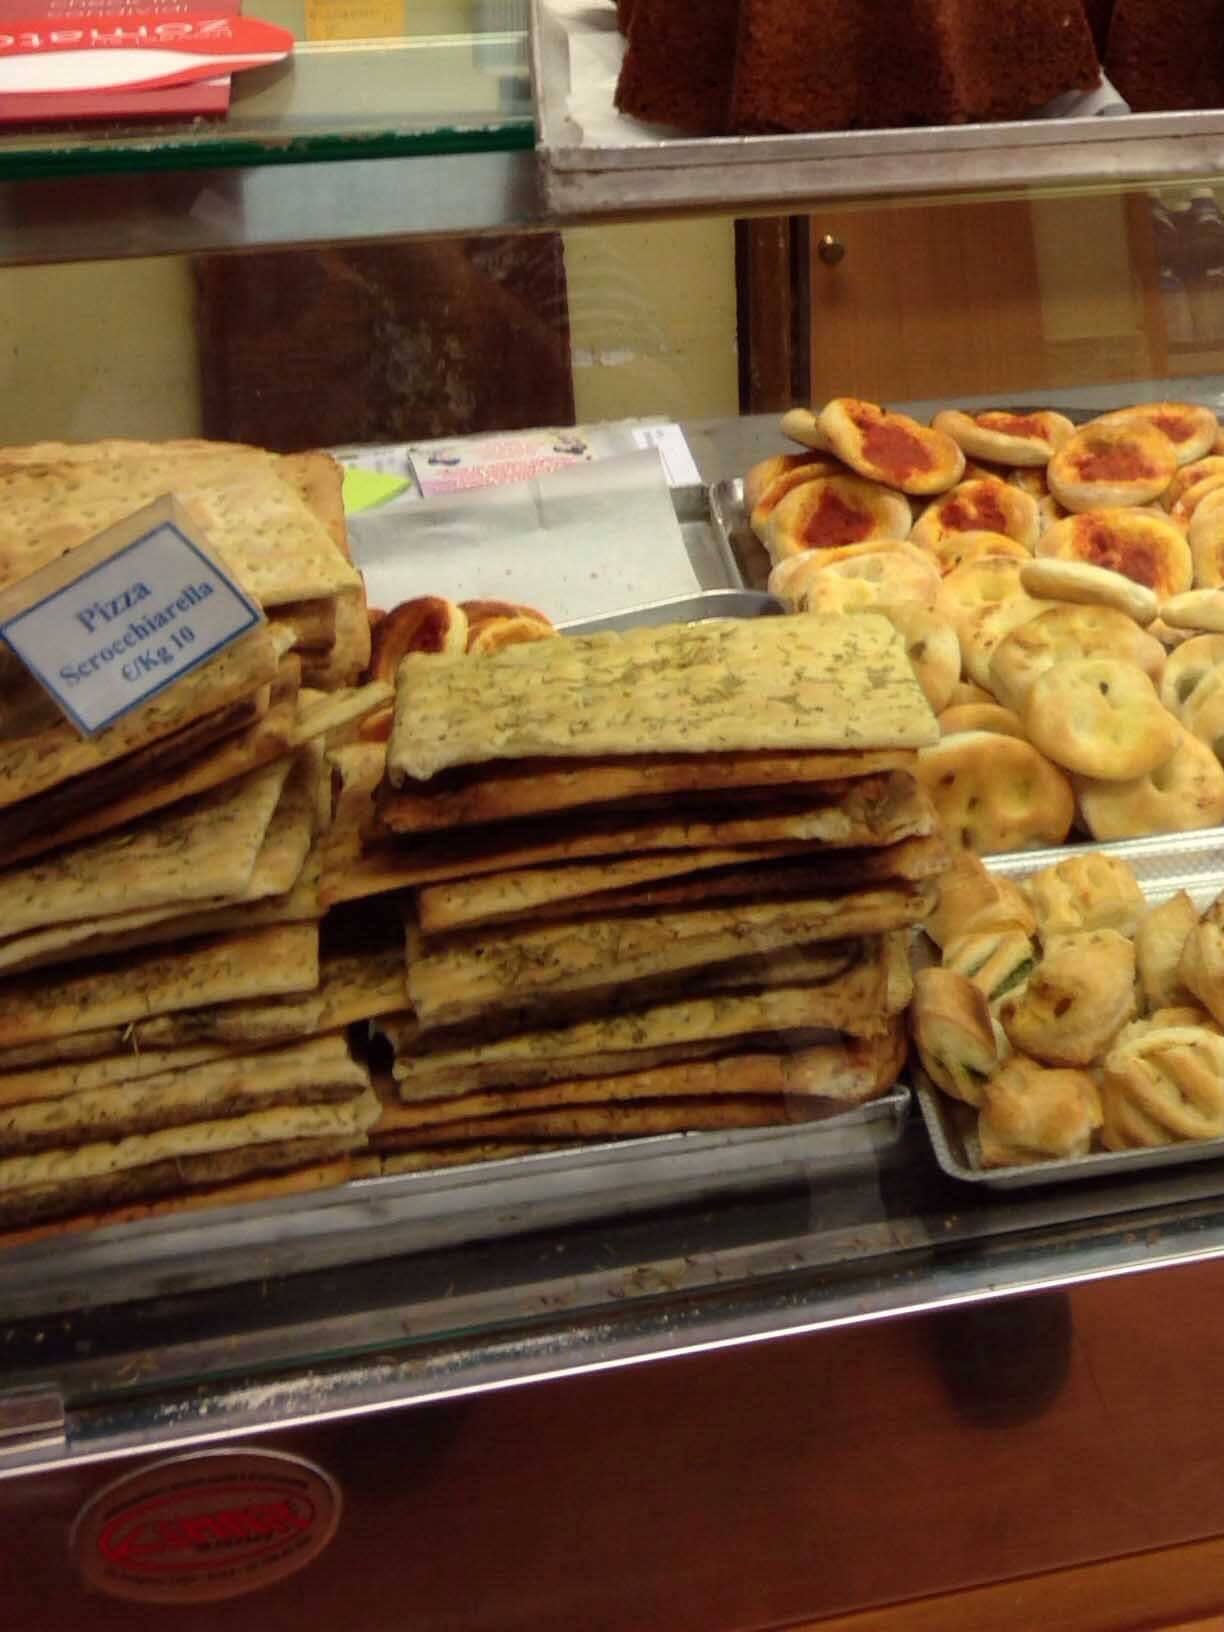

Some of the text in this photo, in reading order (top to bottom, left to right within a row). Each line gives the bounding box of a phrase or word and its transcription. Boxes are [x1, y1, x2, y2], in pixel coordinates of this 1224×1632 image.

[59, 580, 215, 687] Scrocchiarella
[76, 581, 152, 635] Pizza
[170, 624, 196, 650] 10
